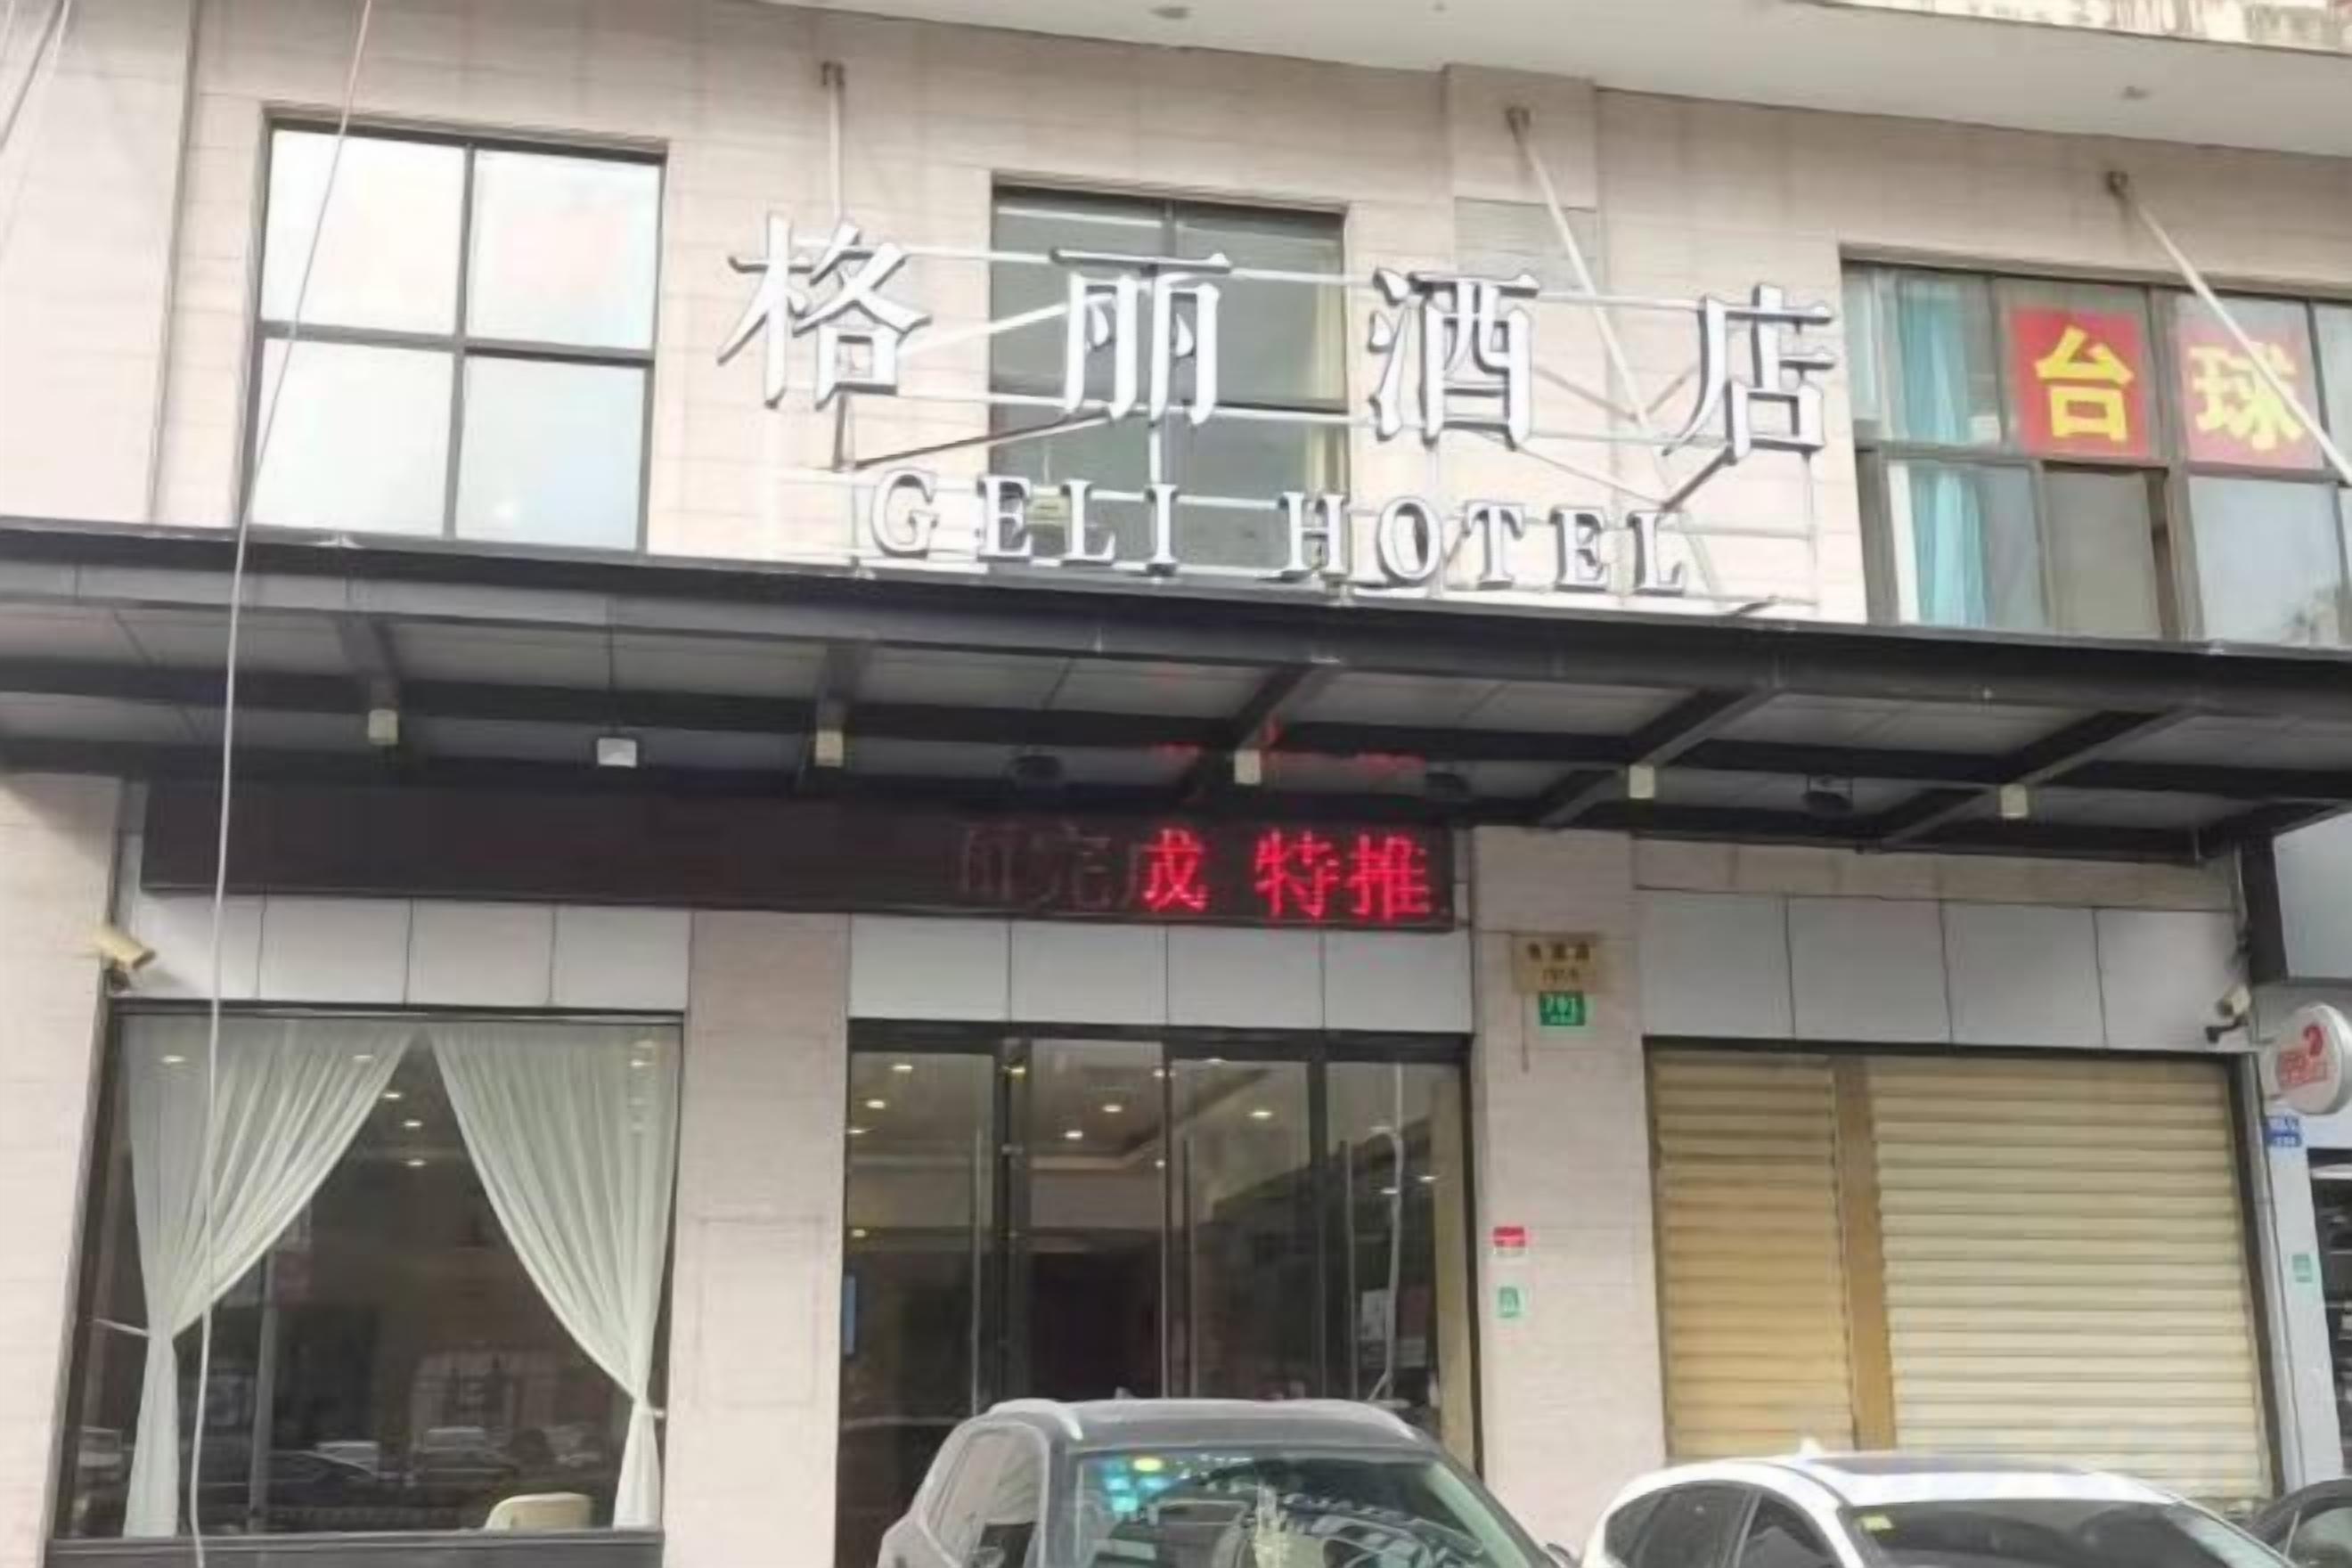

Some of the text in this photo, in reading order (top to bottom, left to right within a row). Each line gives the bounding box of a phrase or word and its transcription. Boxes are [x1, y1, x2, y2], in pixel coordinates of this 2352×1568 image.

[716, 212, 1834, 464] 格丽酒店
[2034, 324, 2305, 452] 台球
[871, 468, 1686, 595] GELI HOTEL
